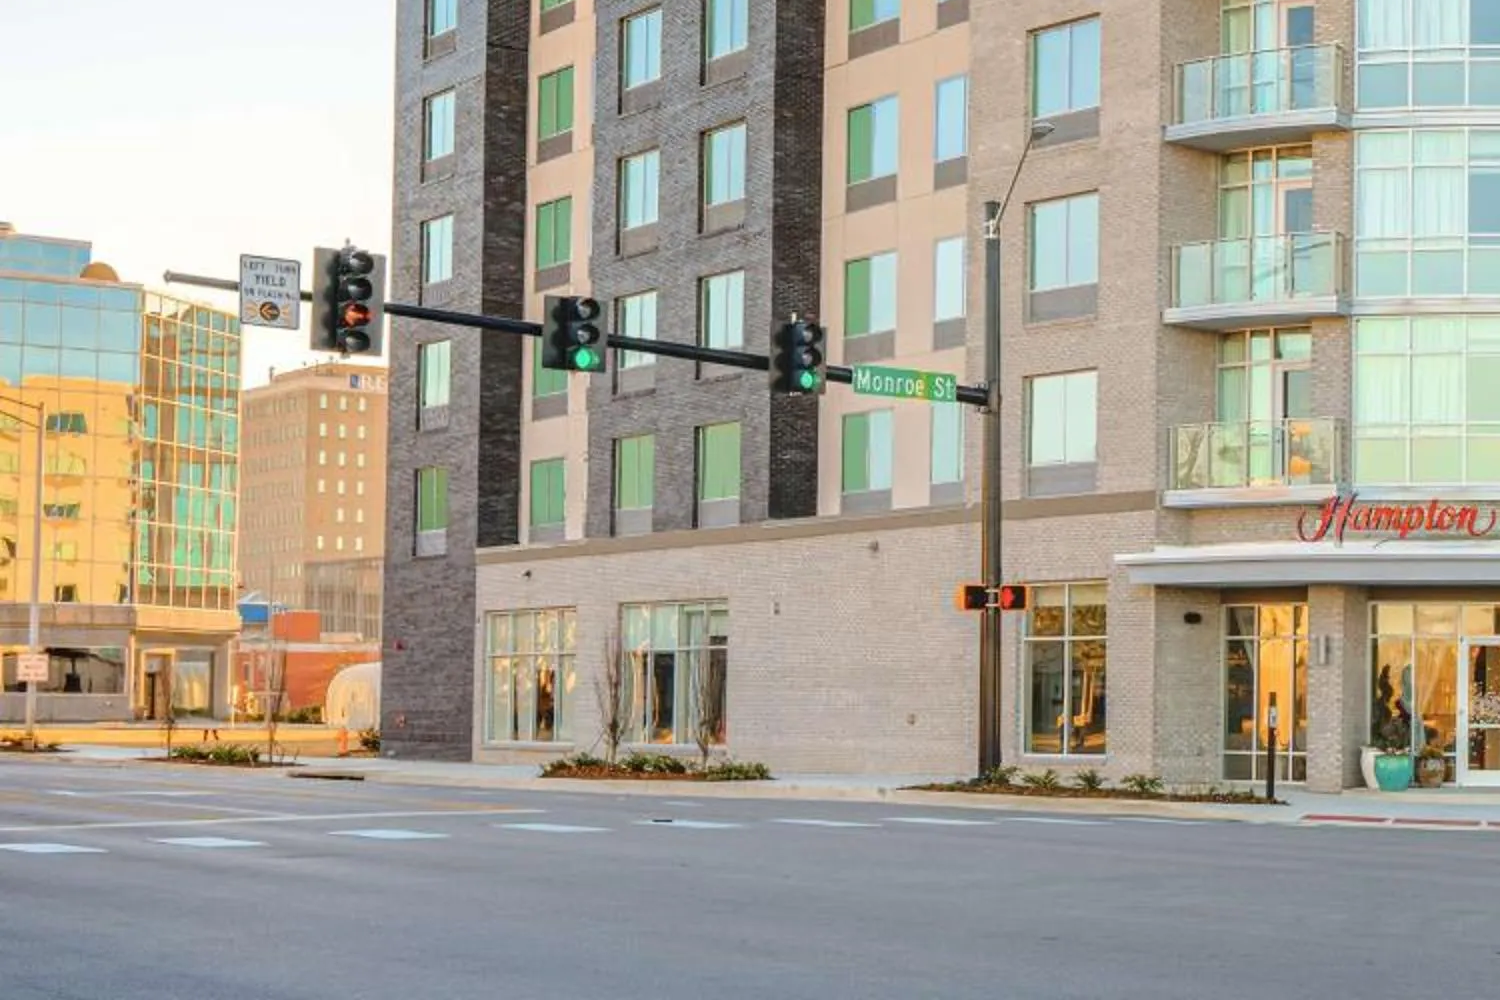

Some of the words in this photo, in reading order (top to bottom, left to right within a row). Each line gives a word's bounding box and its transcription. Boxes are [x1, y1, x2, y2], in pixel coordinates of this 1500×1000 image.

[254, 274, 287, 287] YIELD
[857, 368, 925, 396] Monroe
[934, 375, 953, 399] St
[1298, 491, 1497, 545] Hampton
